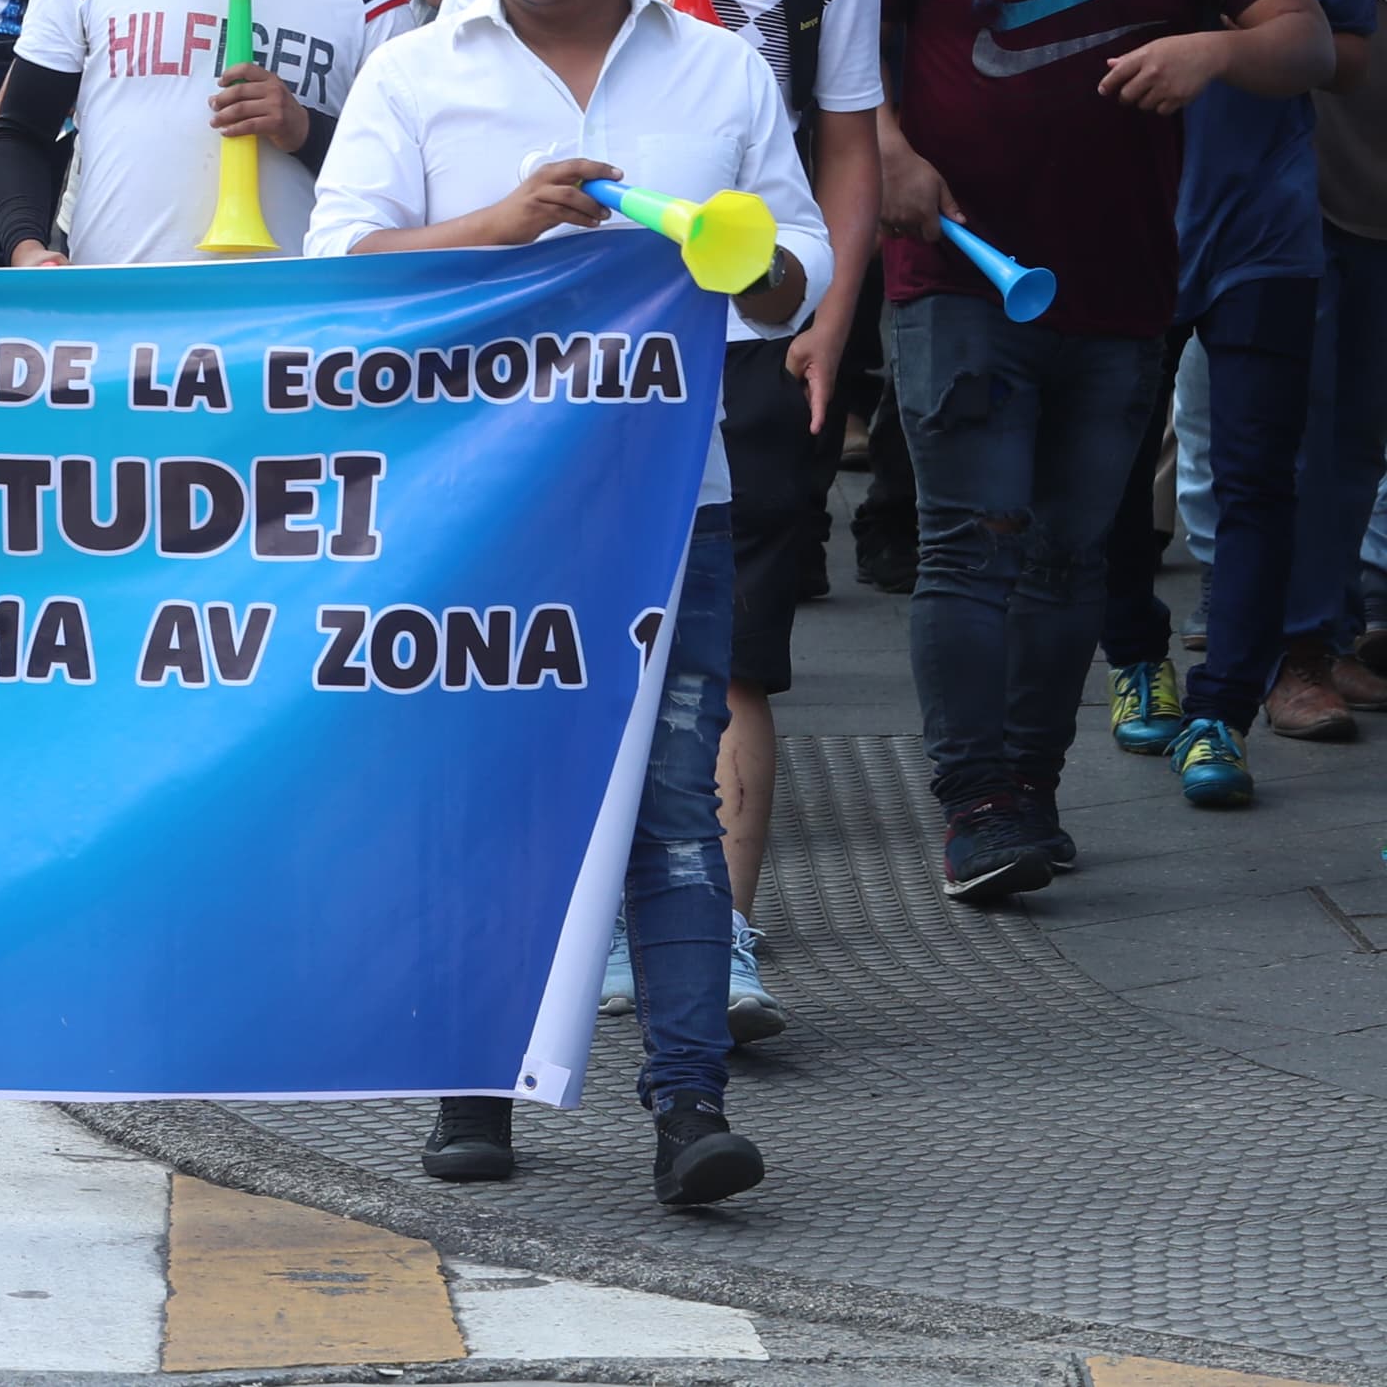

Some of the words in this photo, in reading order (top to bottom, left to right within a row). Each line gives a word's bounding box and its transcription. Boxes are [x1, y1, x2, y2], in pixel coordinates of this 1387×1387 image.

[132, 346, 229, 410] LA
[267, 334, 684, 411] ECONOMIA
[139, 602, 274, 685] AV
[316, 606, 584, 690] ZONA
